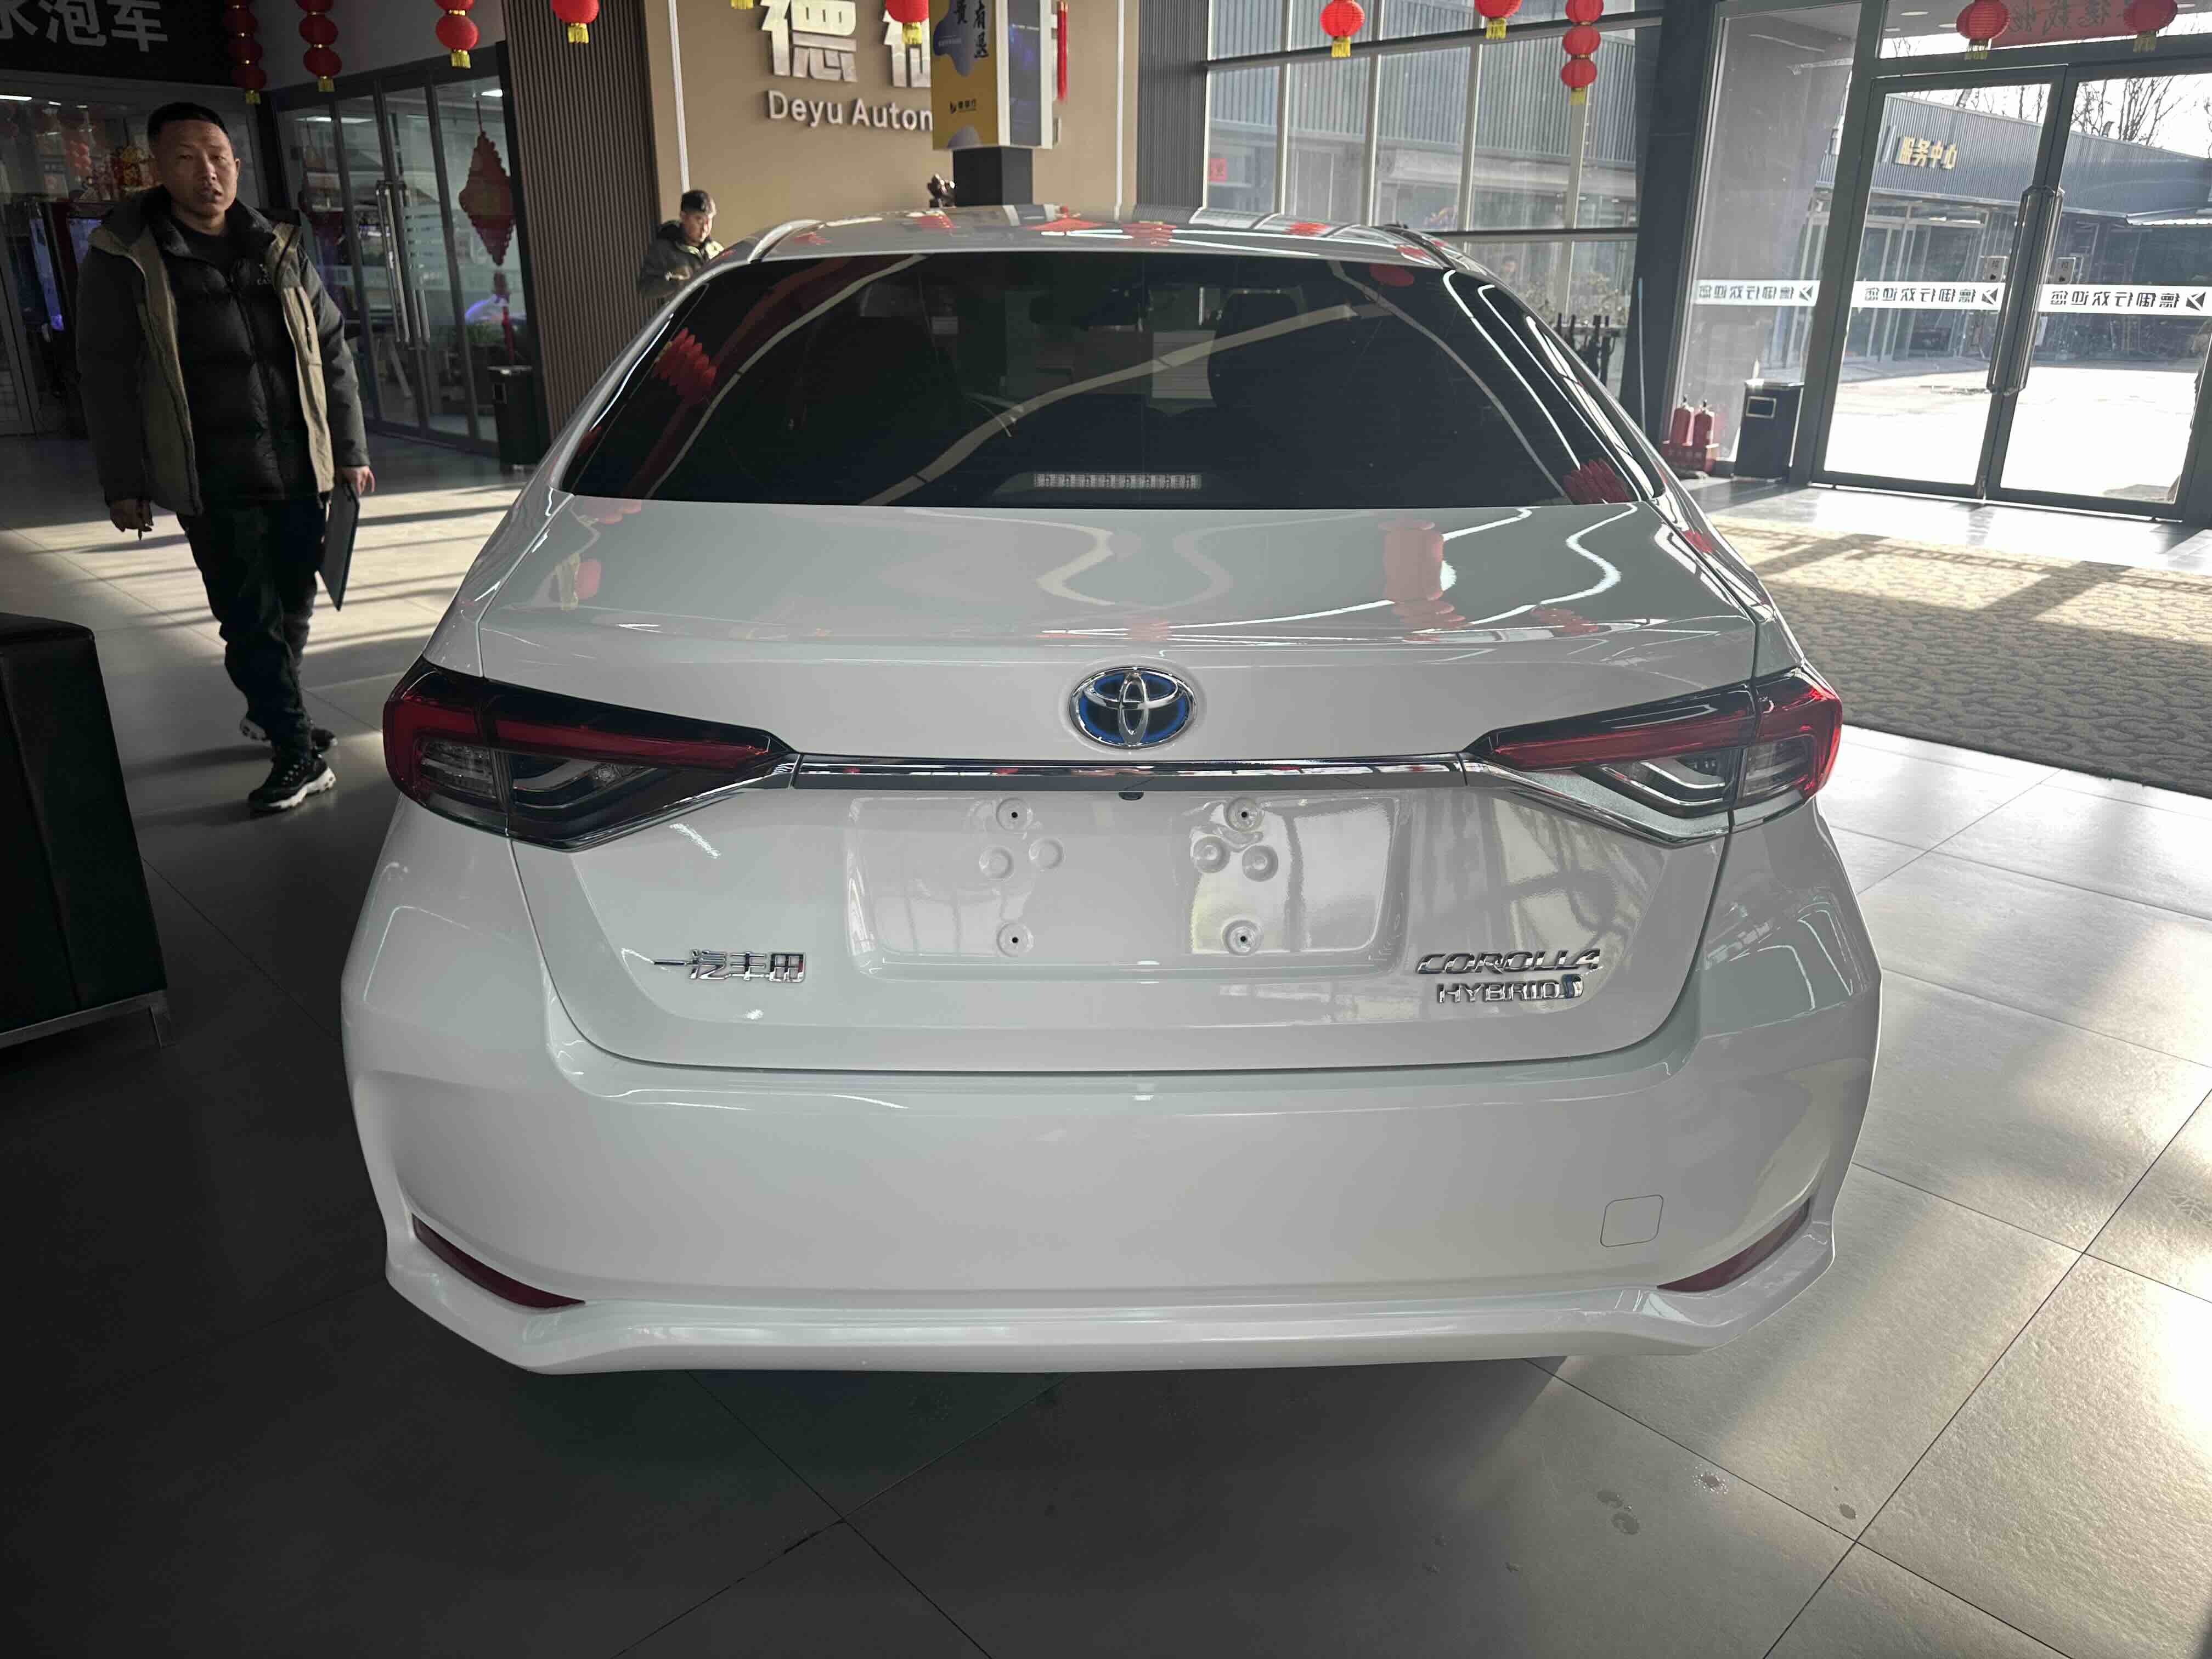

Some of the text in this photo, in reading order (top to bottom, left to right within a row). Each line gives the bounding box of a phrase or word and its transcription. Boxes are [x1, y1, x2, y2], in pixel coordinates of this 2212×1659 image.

[768, 89, 844, 127] Deyu
[653, 948, 806, 984] 一汽丰田
[1416, 948, 1601, 975] COROLLA
[1436, 979, 1561, 1004] HYBRID
